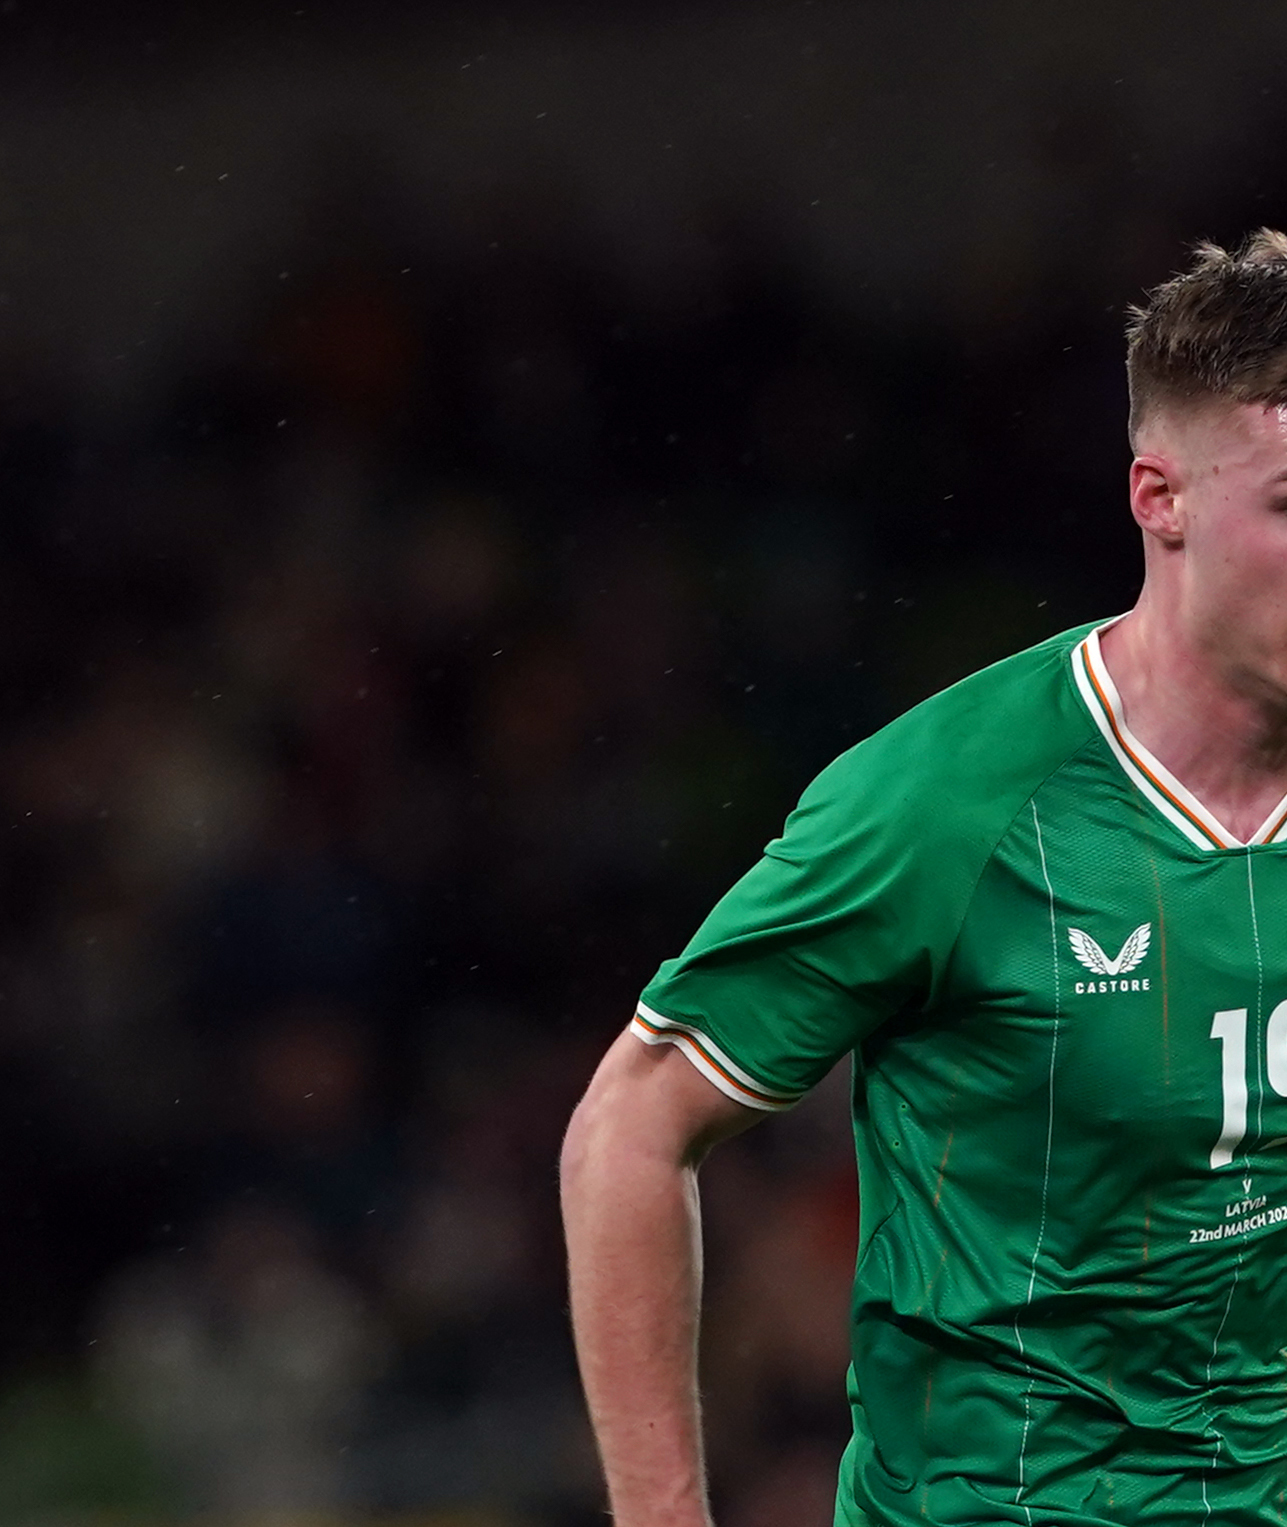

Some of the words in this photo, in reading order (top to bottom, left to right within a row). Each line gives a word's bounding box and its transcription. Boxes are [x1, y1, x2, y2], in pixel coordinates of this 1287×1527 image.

[1075, 978, 1150, 994] CASTORE
[1225, 1195, 1267, 1217] LATVIA
[1189, 1224, 1223, 1243] 22nd
[1224, 1213, 1267, 1238] MARCH
